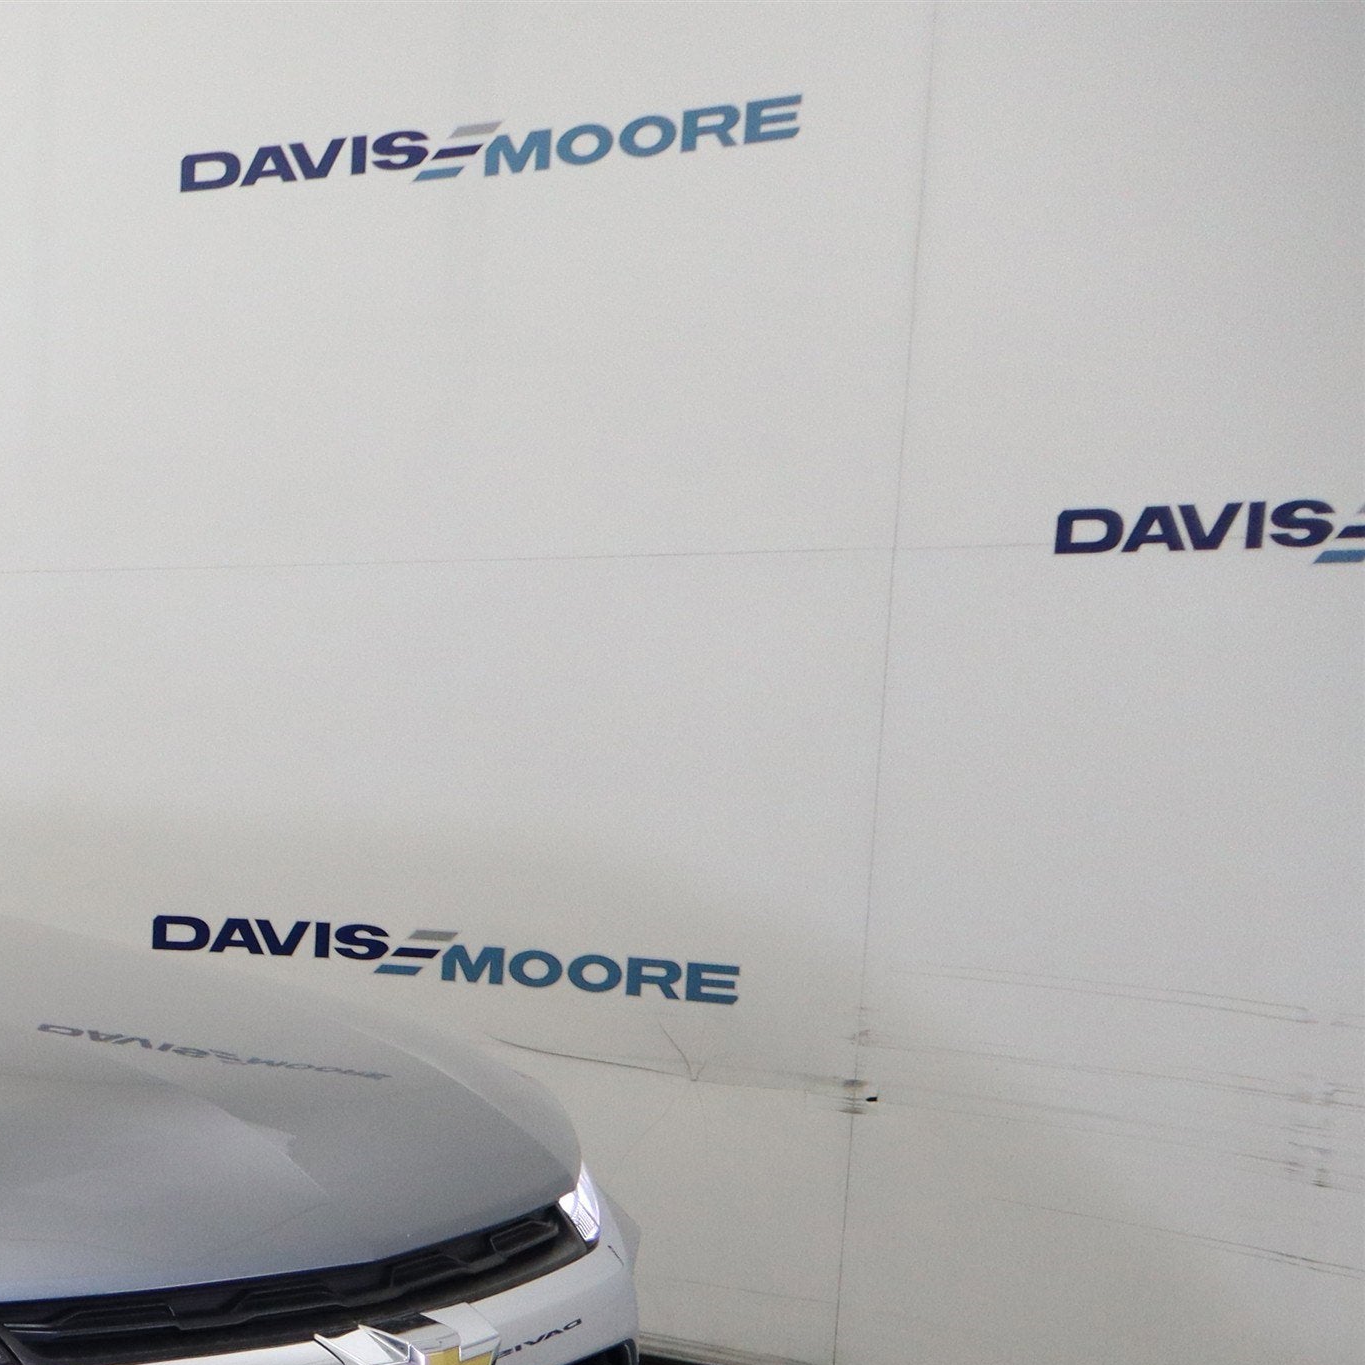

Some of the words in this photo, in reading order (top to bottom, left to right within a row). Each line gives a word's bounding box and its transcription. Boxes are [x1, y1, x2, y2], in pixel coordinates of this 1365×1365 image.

[180, 130, 429, 193] DAVIS
[484, 95, 802, 177] MOORE
[1054, 499, 1335, 555] DAVIS
[151, 914, 390, 961] DAVIS
[441, 944, 740, 1005] MOORE
